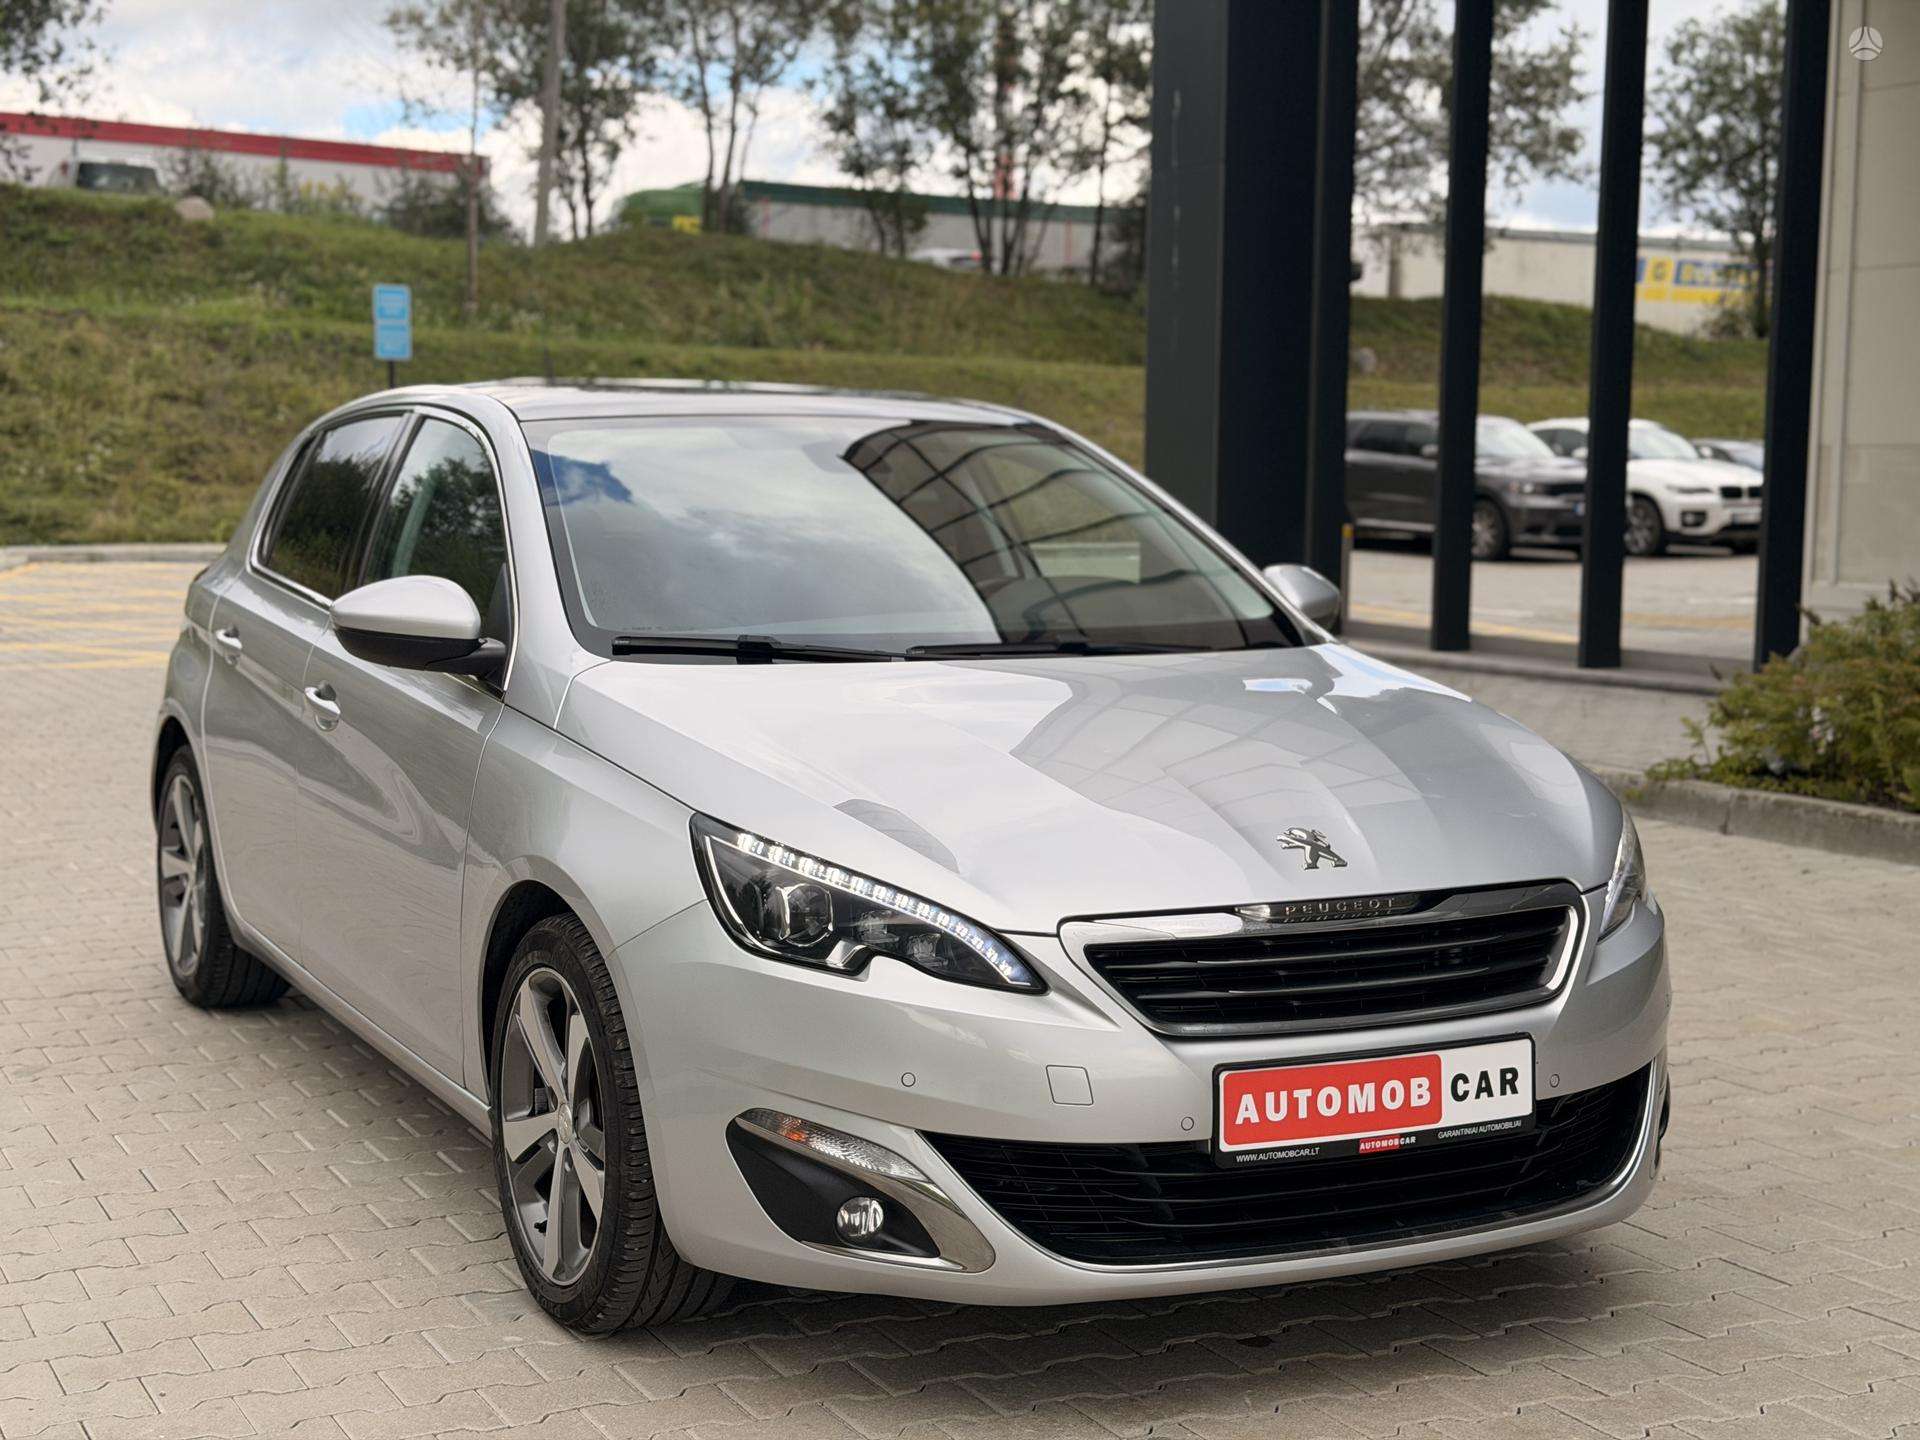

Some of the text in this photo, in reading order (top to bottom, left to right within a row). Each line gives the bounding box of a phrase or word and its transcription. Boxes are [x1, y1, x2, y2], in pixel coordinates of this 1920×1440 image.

[1285, 898, 1395, 916] PEUGEOT
[1235, 1066, 1519, 1125] AUTOMOB CAR
[1438, 1120, 1522, 1140] GARANTINIAI AUTOMOBILIAI
[1236, 1147, 1320, 1163] WWW.AUTOMOBCAR.LT
